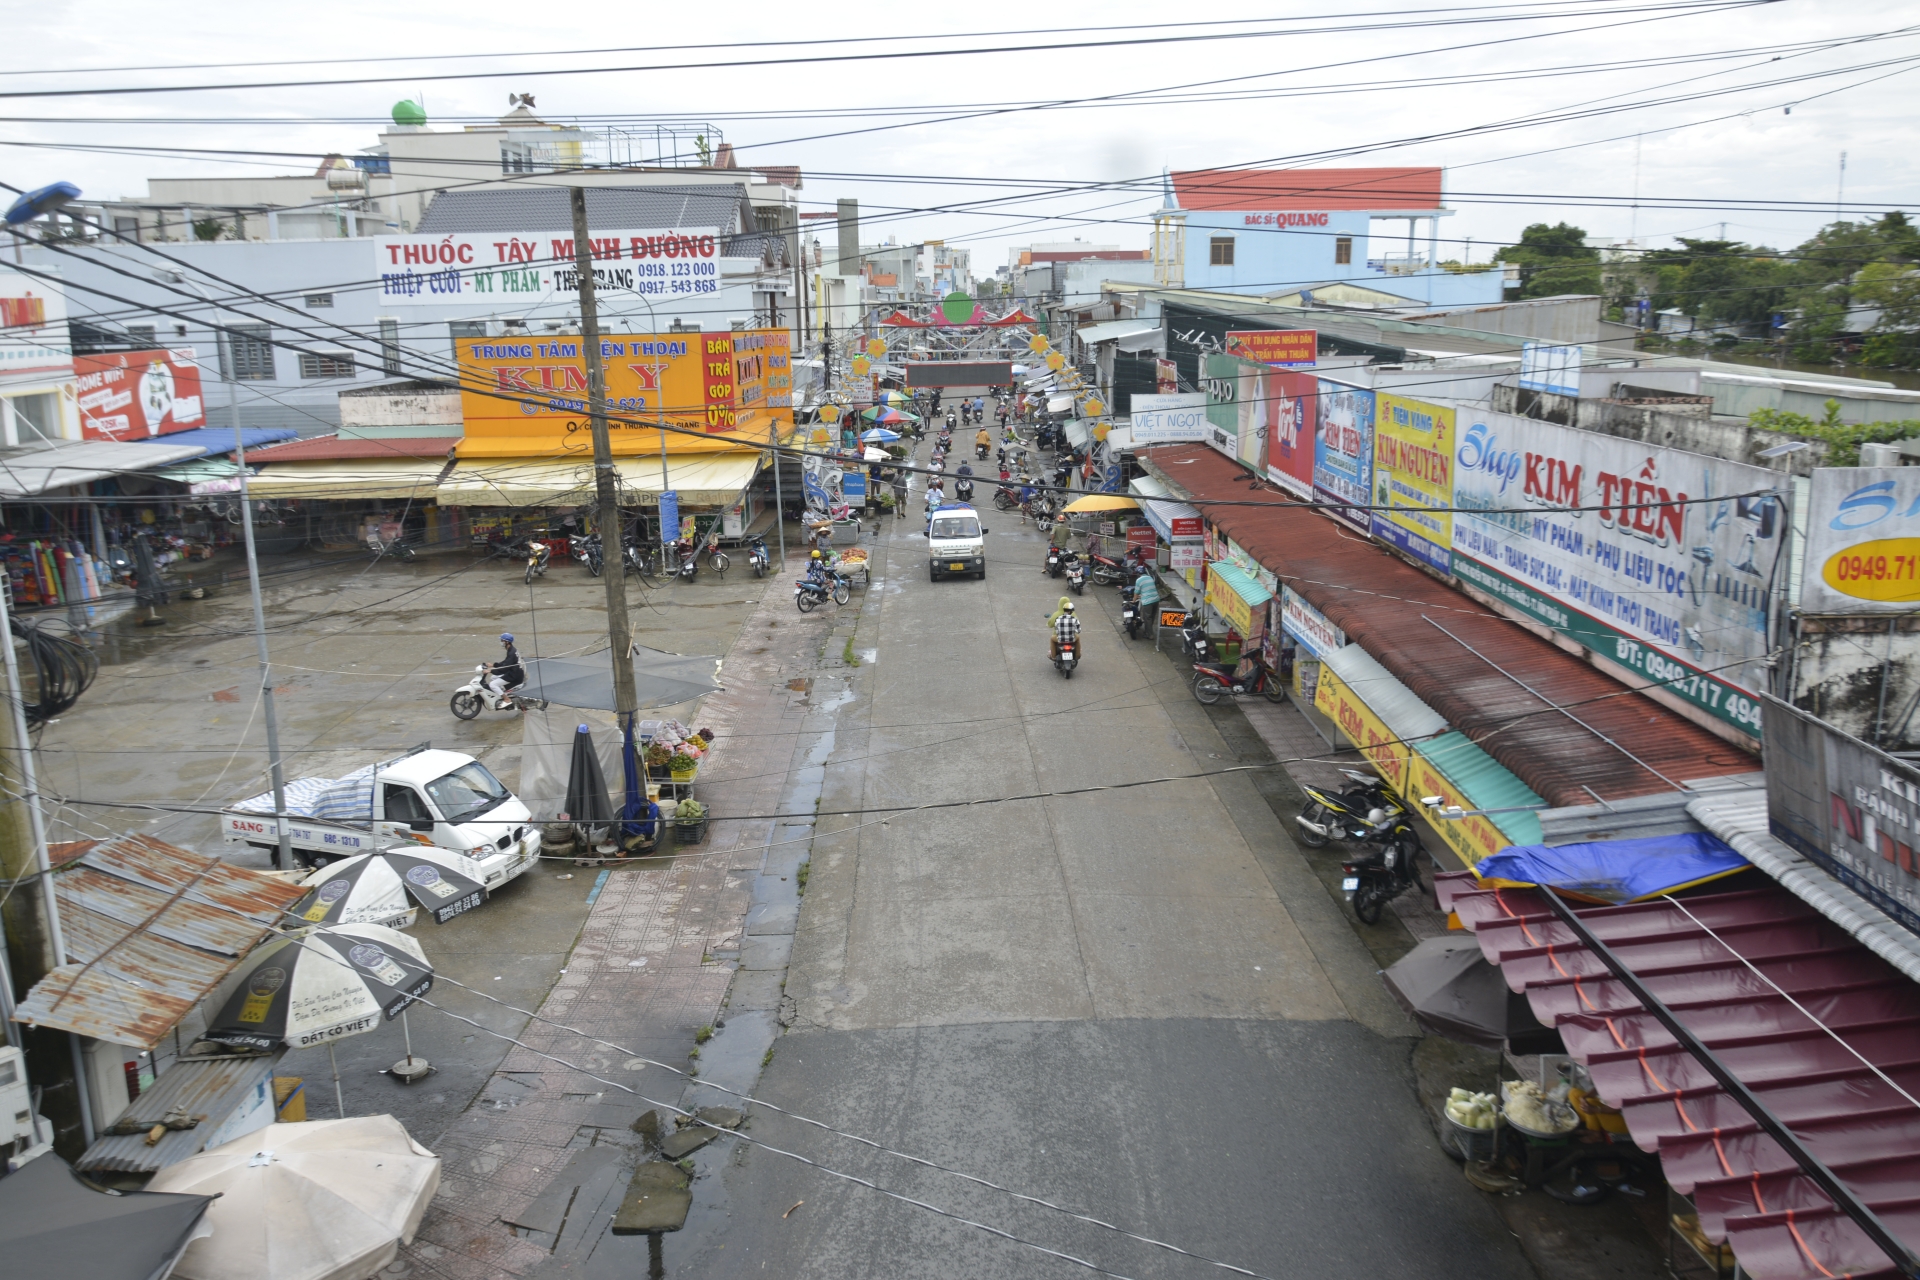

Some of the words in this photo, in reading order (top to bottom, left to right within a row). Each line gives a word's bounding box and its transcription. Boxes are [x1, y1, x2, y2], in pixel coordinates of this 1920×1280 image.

[1245, 213, 1262, 225] BÁC
[1276, 213, 1328, 229] QUANG
[385, 234, 474, 265] THUỐC
[492, 237, 537, 263] TÂY
[551, 238, 621, 261] MNH
[382, 267, 424, 298] THIỆP
[693, 262, 715, 276] 000
[471, 344, 533, 359] TRUNG
[537, 340, 578, 358] TÂM
[630, 341, 687, 359] THOẠI
[706, 337, 730, 354] BÁN
[491, 364, 611, 393] KIM
[628, 363, 669, 391] Y
[708, 357, 731, 377] TRẢ
[709, 382, 732, 399] GÓP
[707, 404, 735, 427] 0%
[1135, 411, 1163, 431] VIỆT
[1168, 413, 1204, 430] NGỌT
[1377, 433, 1398, 469] KIM
[1399, 441, 1449, 488] NGUYÊN
[1457, 421, 1522, 497] Shop
[1523, 451, 1583, 514] KIM
[1597, 457, 1690, 550] TIỀN
[1595, 539, 1621, 578] PHỤ
[1624, 550, 1653, 588] LIỆU
[1656, 560, 1686, 598] TÓC
[1644, 607, 1680, 646] TRANG
[1616, 637, 1643, 668] ĐT:
[1725, 693, 1763, 731] 494
[1339, 697, 1363, 745] KIM
[1855, 785, 1909, 829] BÁNH
[232, 820, 264, 833] SANG
[386, 917, 409, 929] VIỆT
[301, 1032, 324, 1045] ĐẤT
[328, 1023, 343, 1036] CỔ
[345, 1018, 371, 1033] VIỆT
